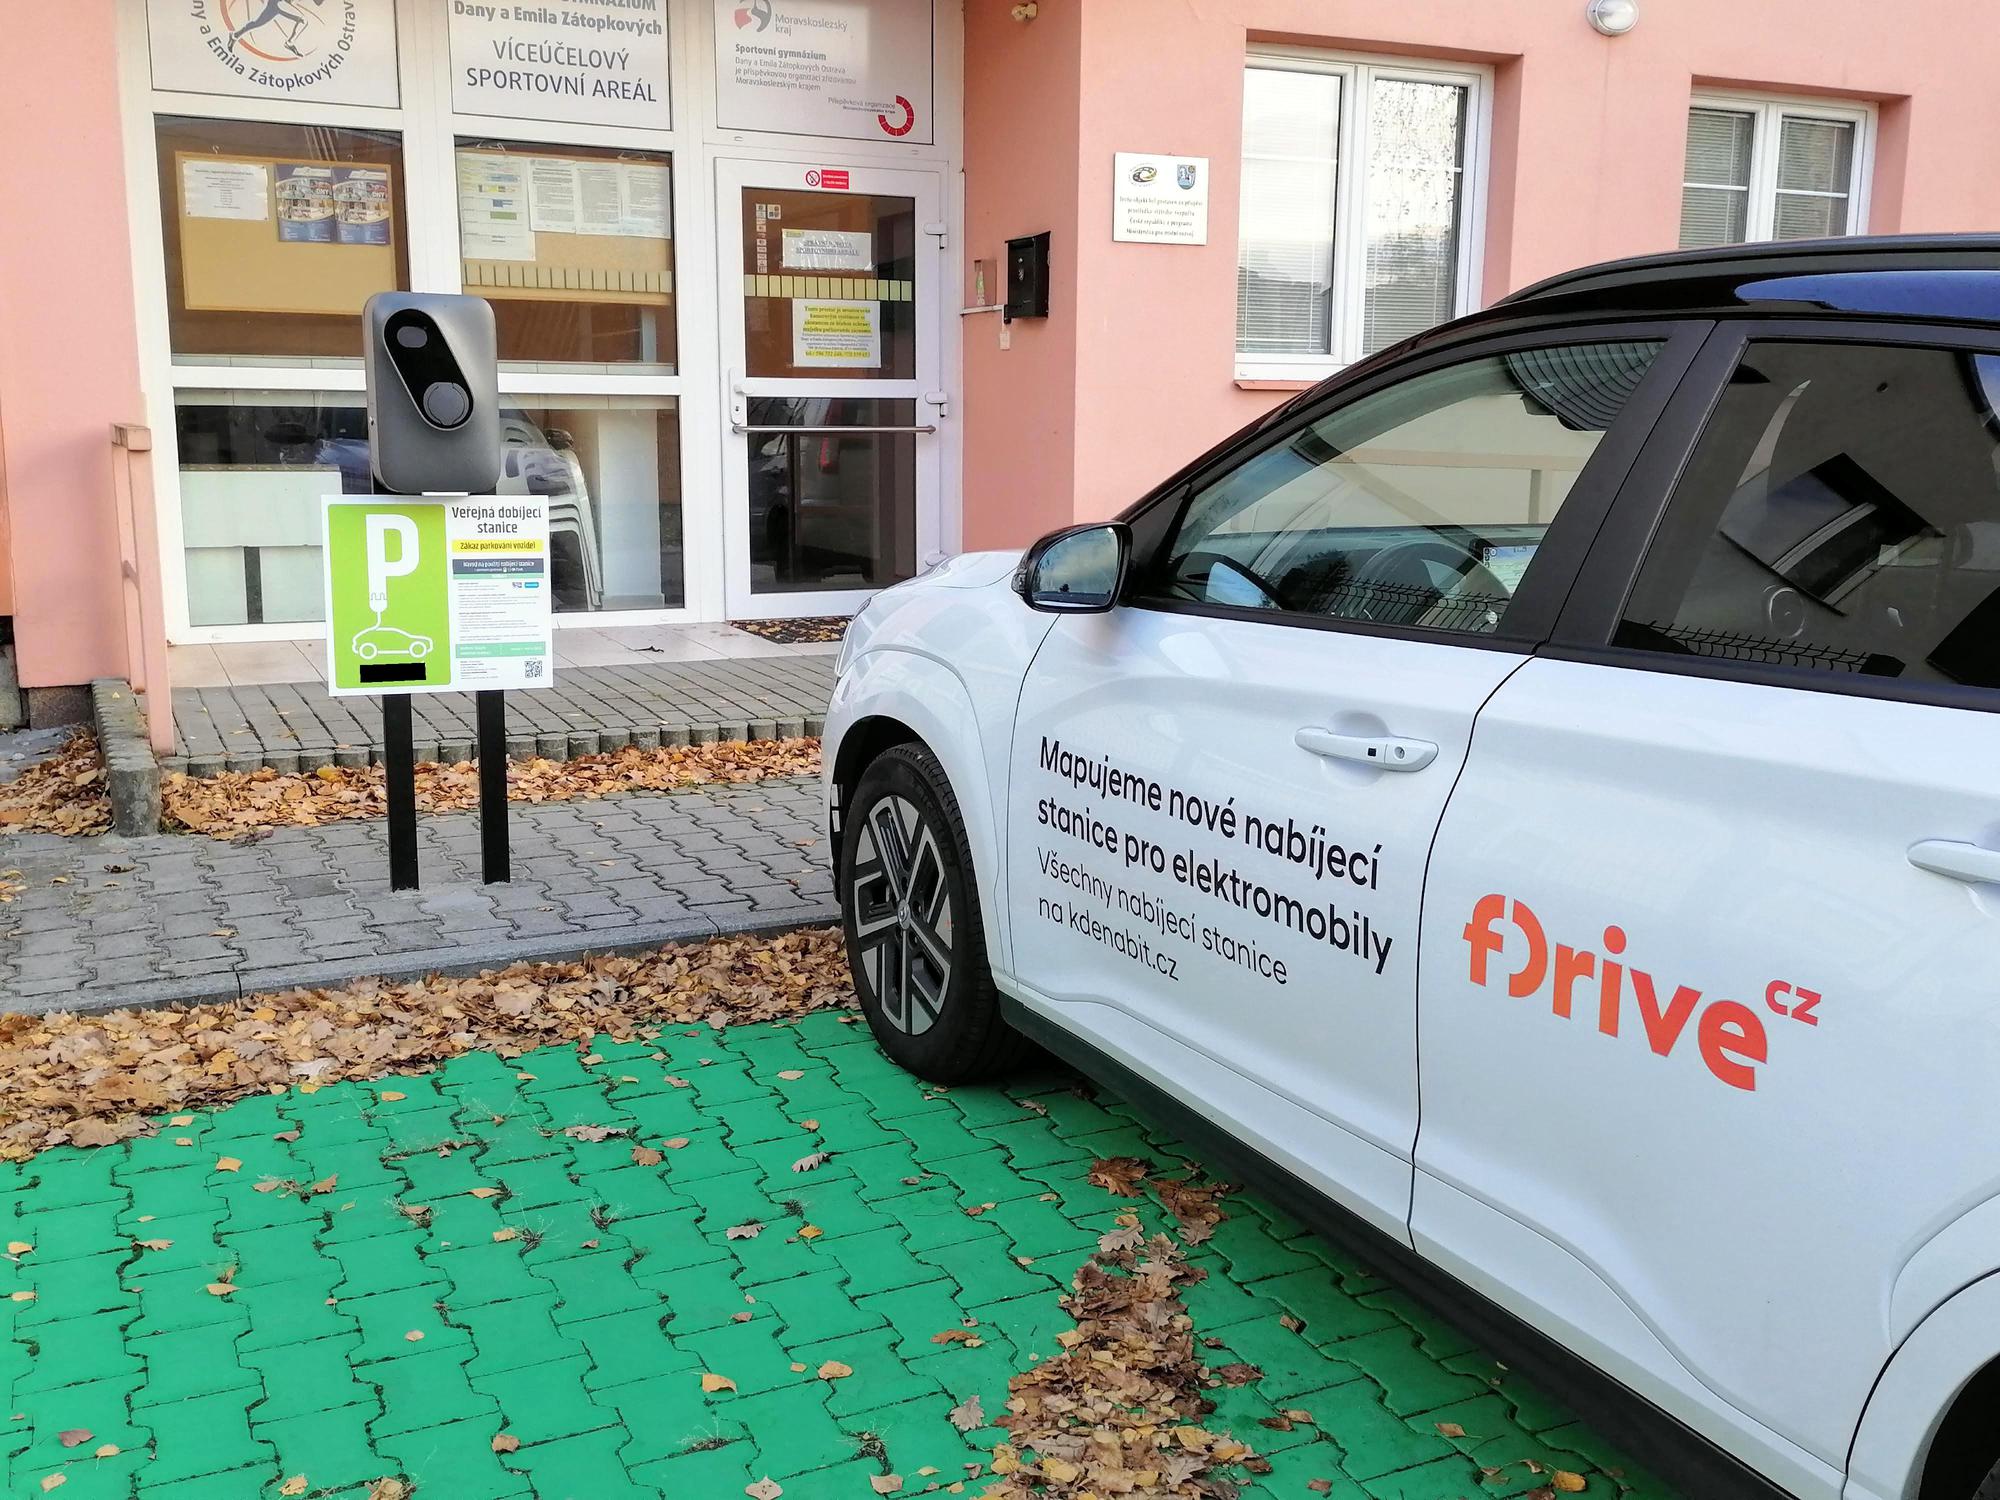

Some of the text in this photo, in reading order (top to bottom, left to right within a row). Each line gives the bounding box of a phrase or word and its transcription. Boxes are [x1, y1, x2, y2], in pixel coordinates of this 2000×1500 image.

[454, 1, 663, 37] Dany a Emila Zátopkových
[775, 13, 848, 33] Moravskoslezský
[775, 25, 792, 37] kraj
[200, 25, 211, 35] a
[207, 37, 245, 75] Emila
[248, 54, 345, 92] Zátopkových
[492, 36, 630, 70] VÍCEÚČELOVÝ
[735, 43, 827, 61] Sportovní gymnázium
[735, 56, 752, 67] Dany
[760, 59, 777, 68] Emila
[779, 60, 822, 73] Zátopkových
[821, 65, 845, 74] Ostrava
[466, 68, 657, 102] SPORTOVNÍ AREÁL
[735, 77, 821, 91] Moravskoslezským krajem
[451, 505, 542, 520] Veřejná dobíjecí
[477, 521, 518, 533] stanice
[365, 513, 420, 600] P
[460, 541, 536, 551] Zákaz parkování vozidel
[1039, 735, 1383, 890] Mapujeme nové nabíjecí
[1037, 797, 1393, 975] stanice pro elektromobily
[1037, 846, 1287, 985] Všechny nabíjecí stanice
[1038, 895, 1180, 982] na kdenabit.cz
